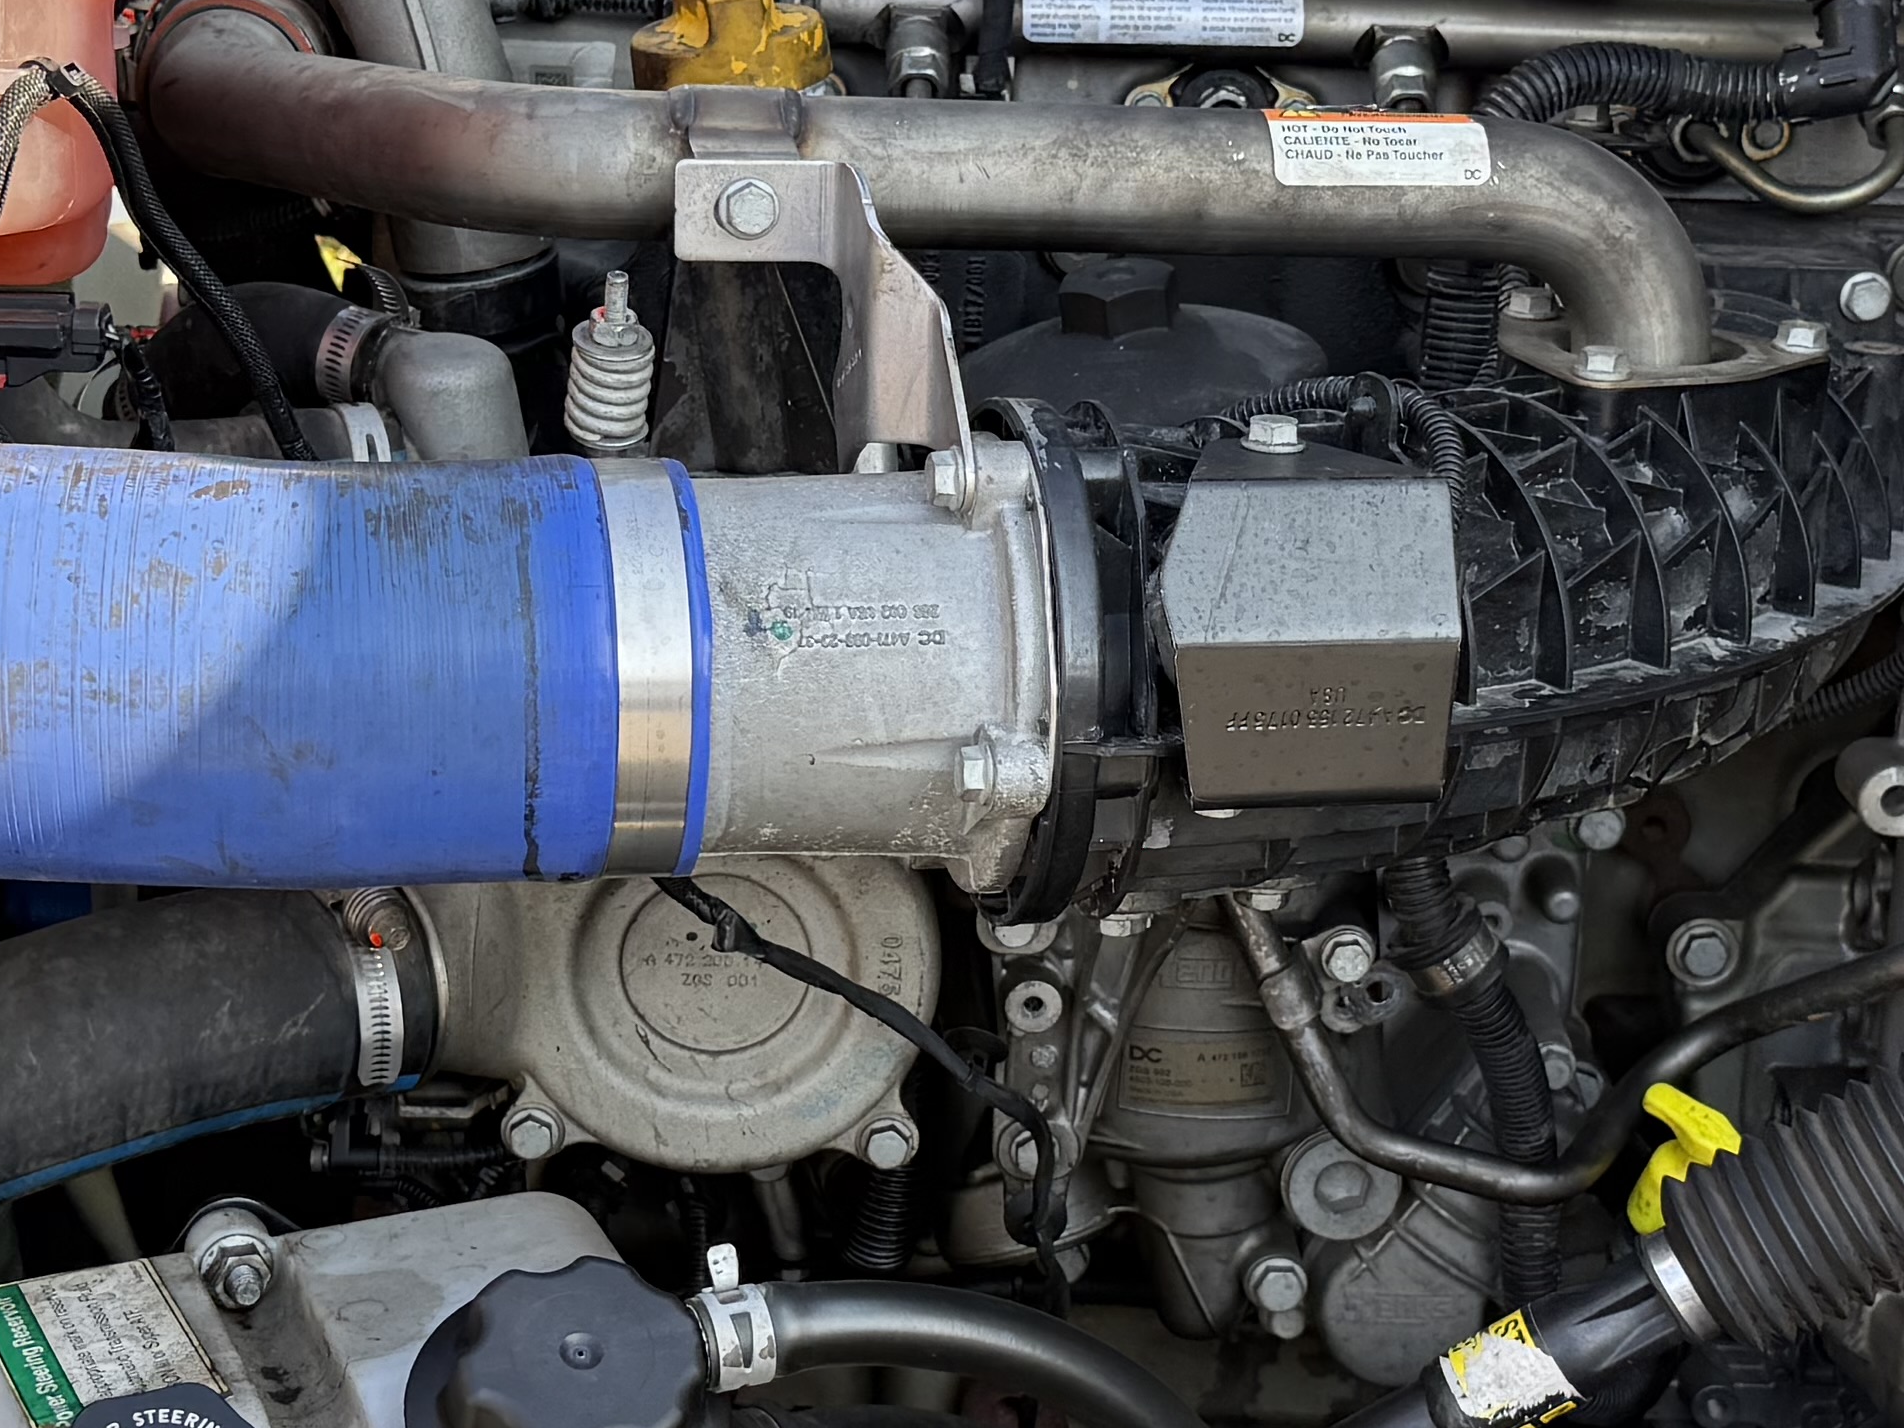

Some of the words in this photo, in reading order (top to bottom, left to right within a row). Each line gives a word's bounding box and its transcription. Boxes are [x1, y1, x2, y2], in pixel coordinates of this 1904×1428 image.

[1320, 125, 1339, 134] Do
[1367, 125, 1407, 134] Touch
[1283, 136, 1351, 146] CALIENTE
[1362, 136, 1380, 147] No
[1382, 136, 1418, 147] Tocar
[1285, 149, 1334, 160] CHAUD
[1392, 150, 1445, 161] Toucher
[1464, 169, 1482, 180] DC
[1309, 686, 1346, 705] USA
[663, 953, 696, 968] 472
[1128, 1044, 1163, 1063] DC
[1197, 1053, 1206, 1062] A
[24, 1346, 59, 1393] Steering
